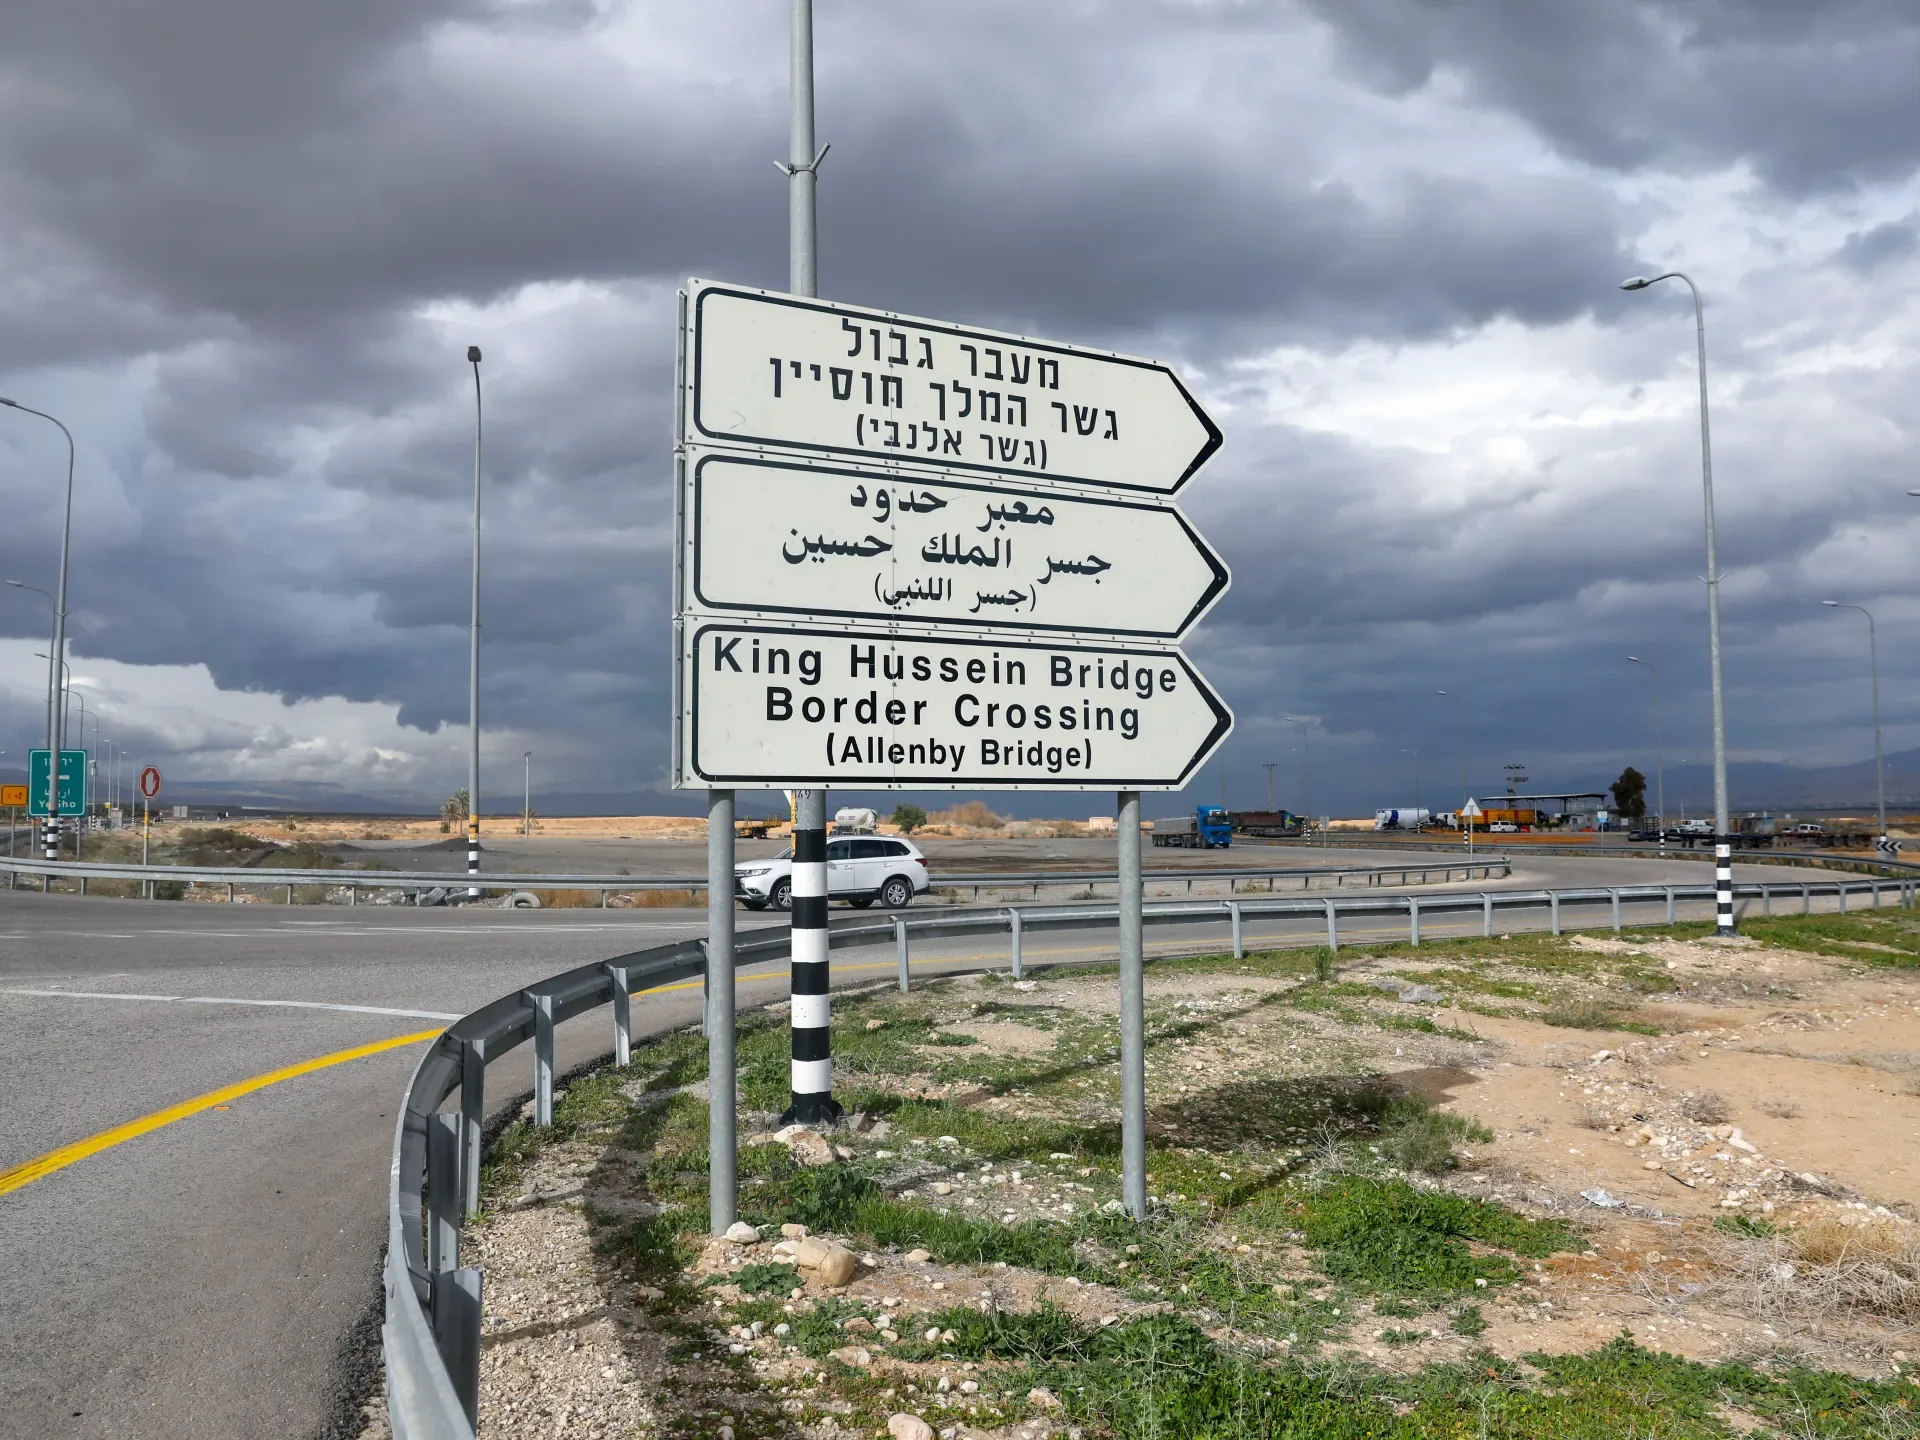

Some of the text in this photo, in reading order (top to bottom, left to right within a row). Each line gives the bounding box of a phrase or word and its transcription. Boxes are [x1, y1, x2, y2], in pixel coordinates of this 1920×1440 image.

[841, 317, 1059, 391] מעבר גבול
[769, 357, 1119, 441] גשר המלך חוסיין
[856, 413, 1047, 470] (גשר אלנבי)
[850, 484, 1055, 533] معبر حدود
[782, 528, 1112, 585] جسر الملك حسين
[714, 636, 1177, 700] King Hussein Bridge
[766, 686, 1139, 741] Border Crossing
[826, 732, 1092, 774] (Allenby Bridge)
